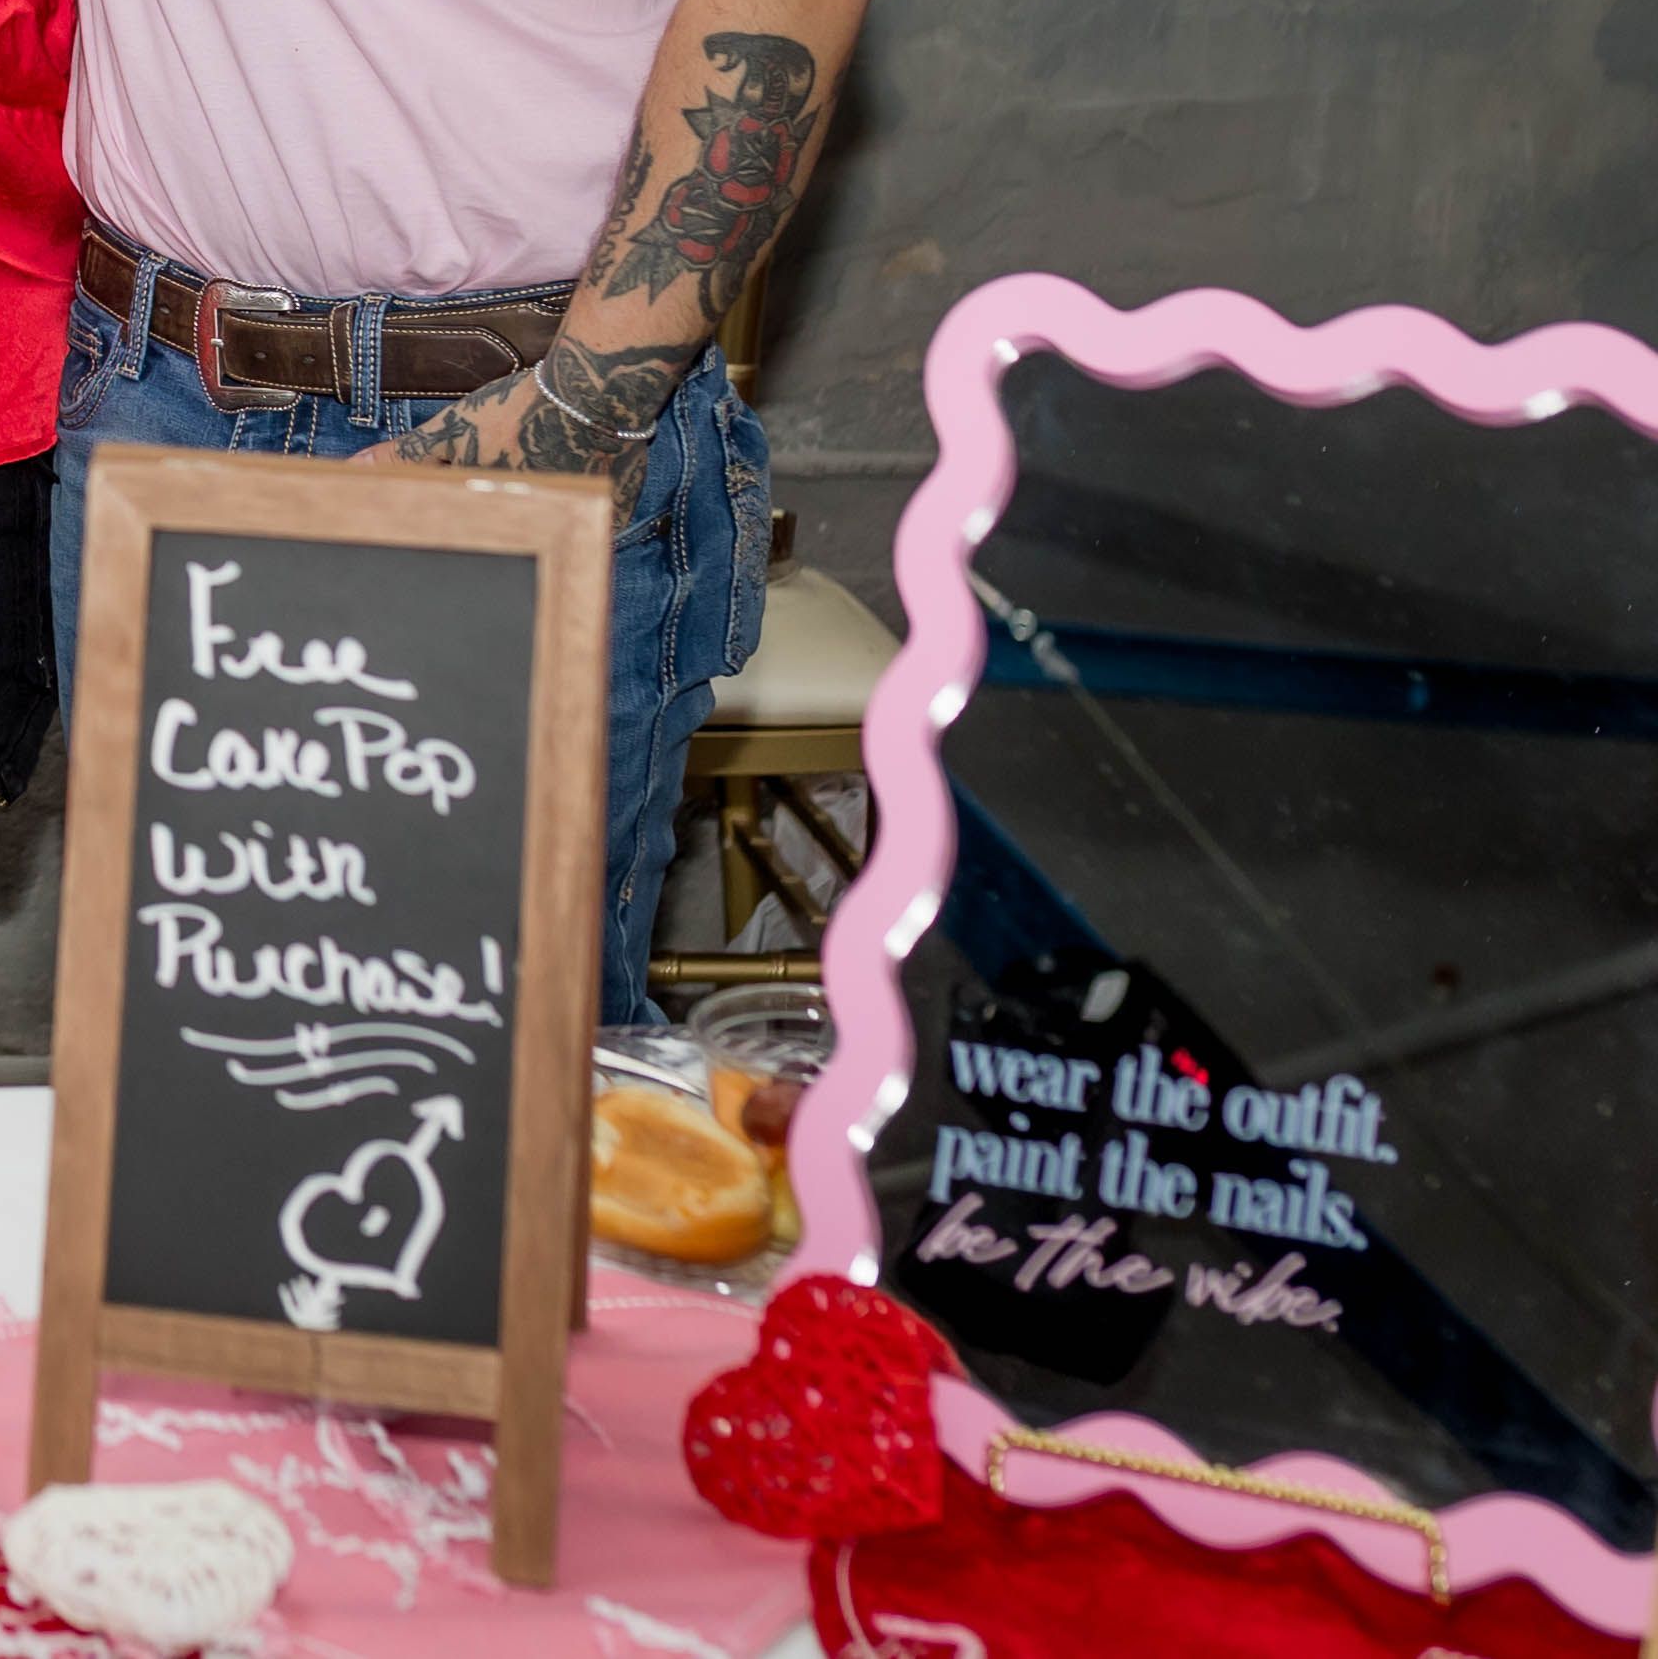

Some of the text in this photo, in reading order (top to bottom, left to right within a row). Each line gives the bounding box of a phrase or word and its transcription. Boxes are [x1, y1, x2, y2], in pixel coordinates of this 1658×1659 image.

[187, 560, 418, 700] Free
[950, 1040, 1398, 1164] wear the outfit.
[929, 1112, 1368, 1251] paint the nails.
[916, 1192, 1343, 1333] be the vibe.
